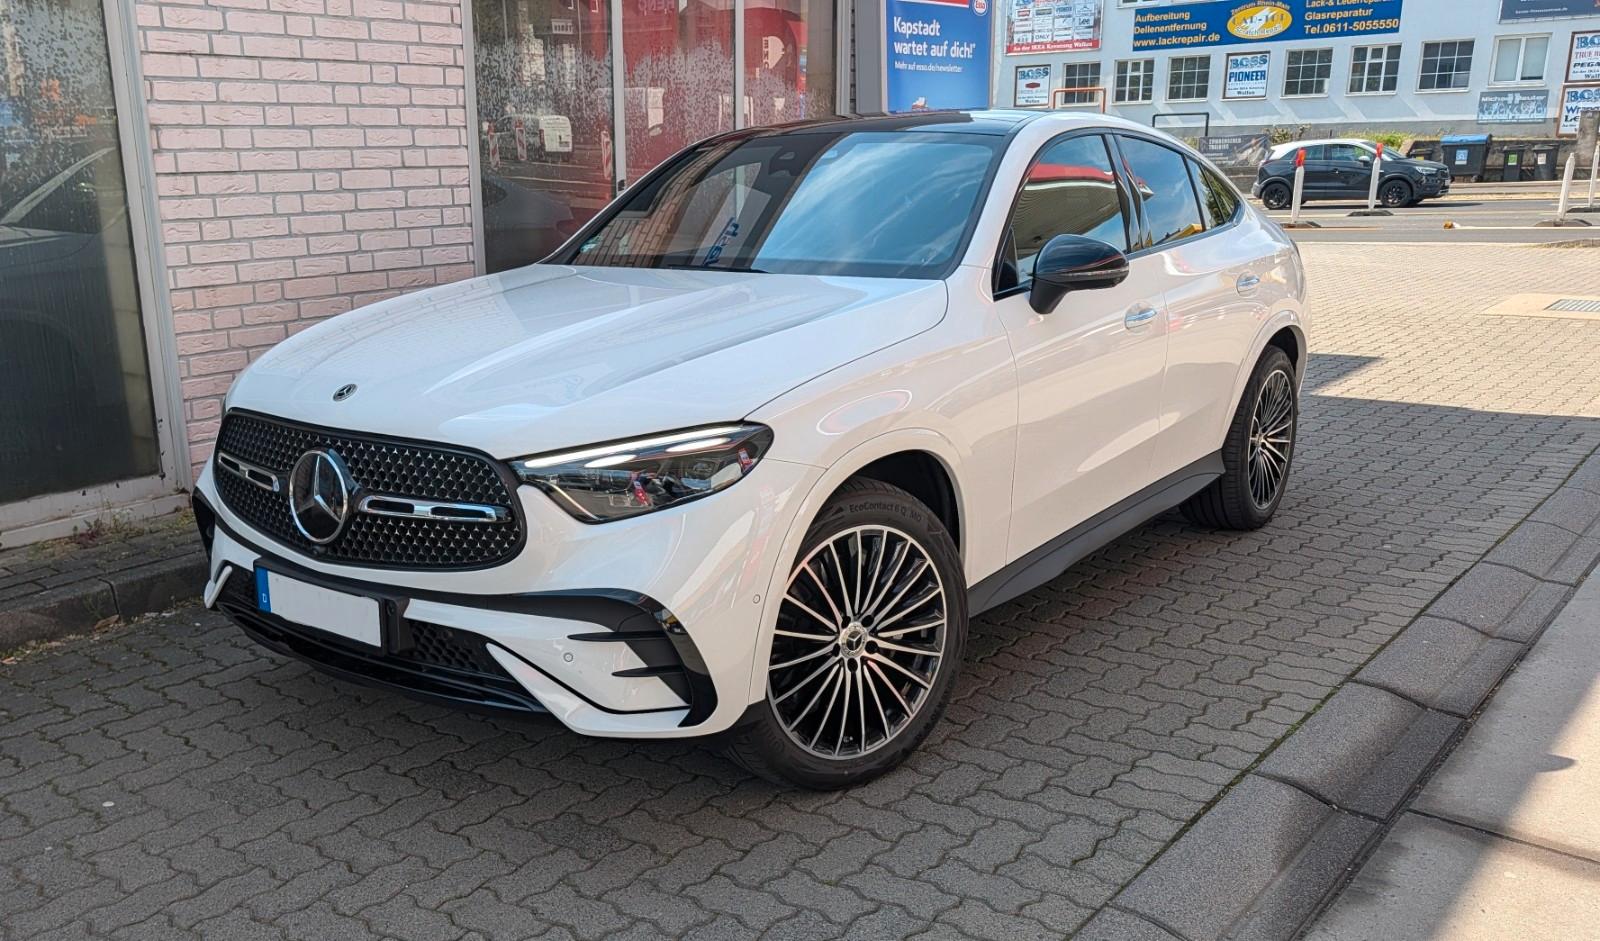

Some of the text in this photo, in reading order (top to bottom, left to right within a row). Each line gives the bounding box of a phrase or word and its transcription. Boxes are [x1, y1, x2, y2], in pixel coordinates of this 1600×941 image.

[1135, 11, 1191, 23] Aufbereitung
[1304, 8, 1374, 21] Glasreparatur
[893, 16, 941, 38] Kapstadt
[1134, 22, 1208, 35] Dellenentfernung
[1304, 18, 1399, 34] Tel.0611-5055550
[1133, 32, 1221, 48] www.lackrepair.de
[893, 41, 928, 56] wartet
[930, 40, 949, 58] auf
[1574, 51, 1593, 59] TRUE
[1230, 54, 1268, 70] BOSS
[1018, 67, 1049, 80] BOSS
[1228, 70, 1266, 83] PIONEER
[849, 502, 894, 513] EcoContact
[894, 504, 900, 512] 6
[262, 592, 268, 603] D
